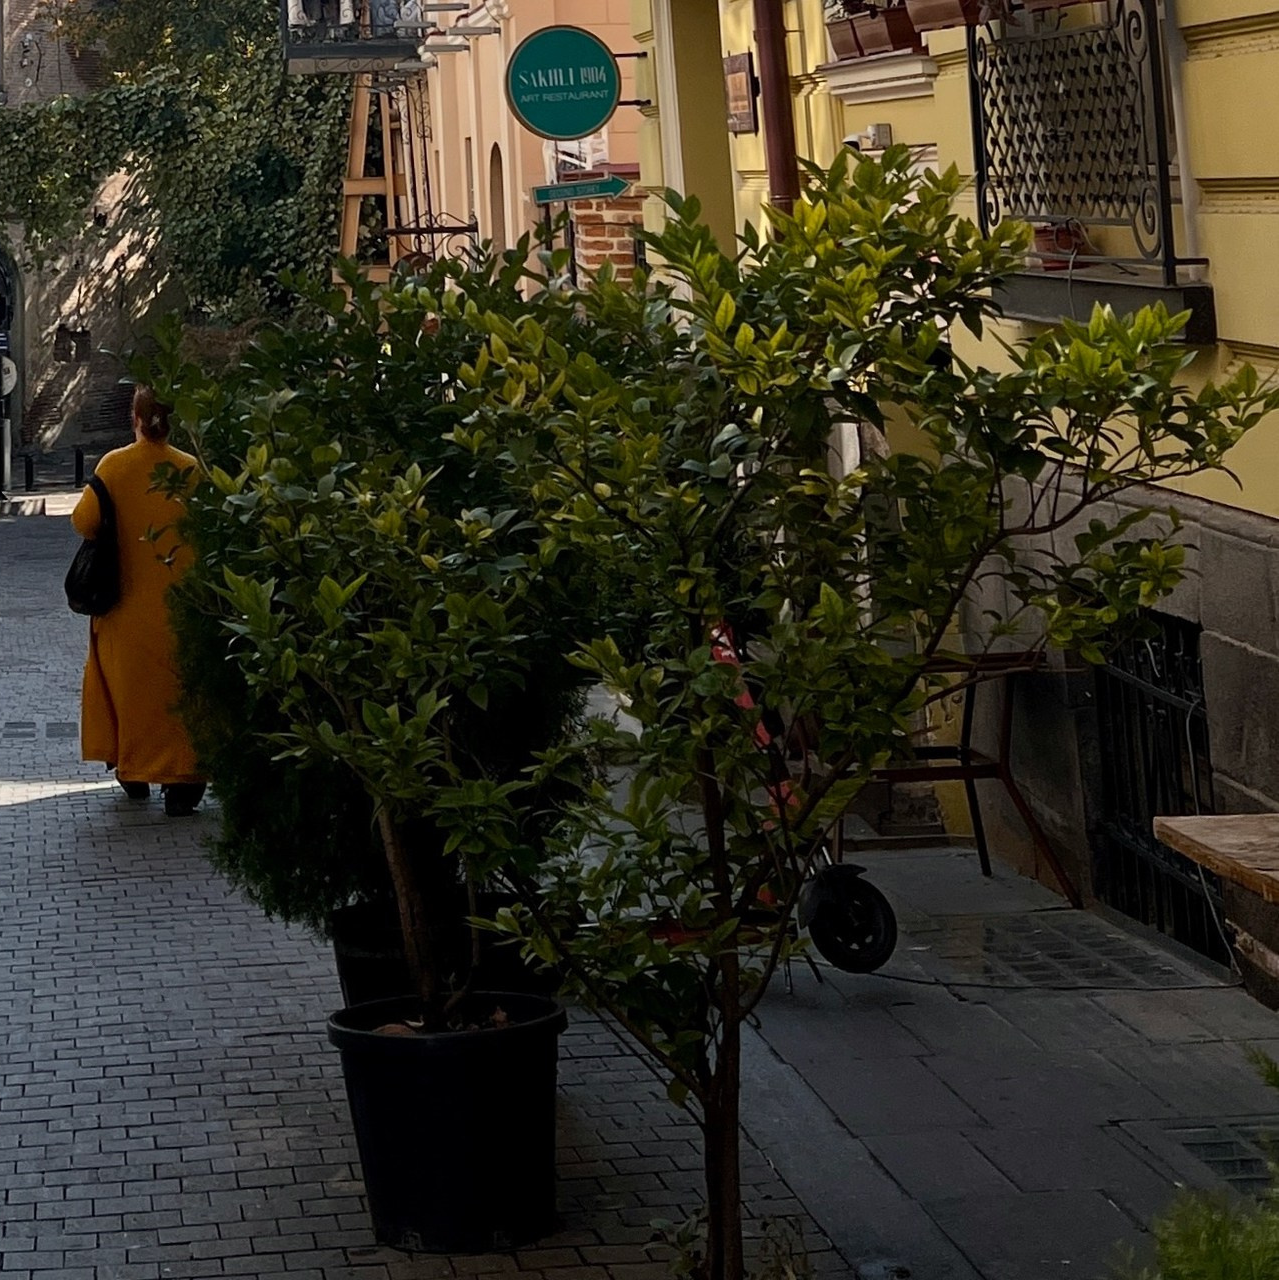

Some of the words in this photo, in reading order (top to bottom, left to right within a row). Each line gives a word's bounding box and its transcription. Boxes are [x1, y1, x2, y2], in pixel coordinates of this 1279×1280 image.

[580, 66, 607, 85] 1904
[521, 94, 540, 103] ART
[542, 90, 609, 101] RESTAURANT
